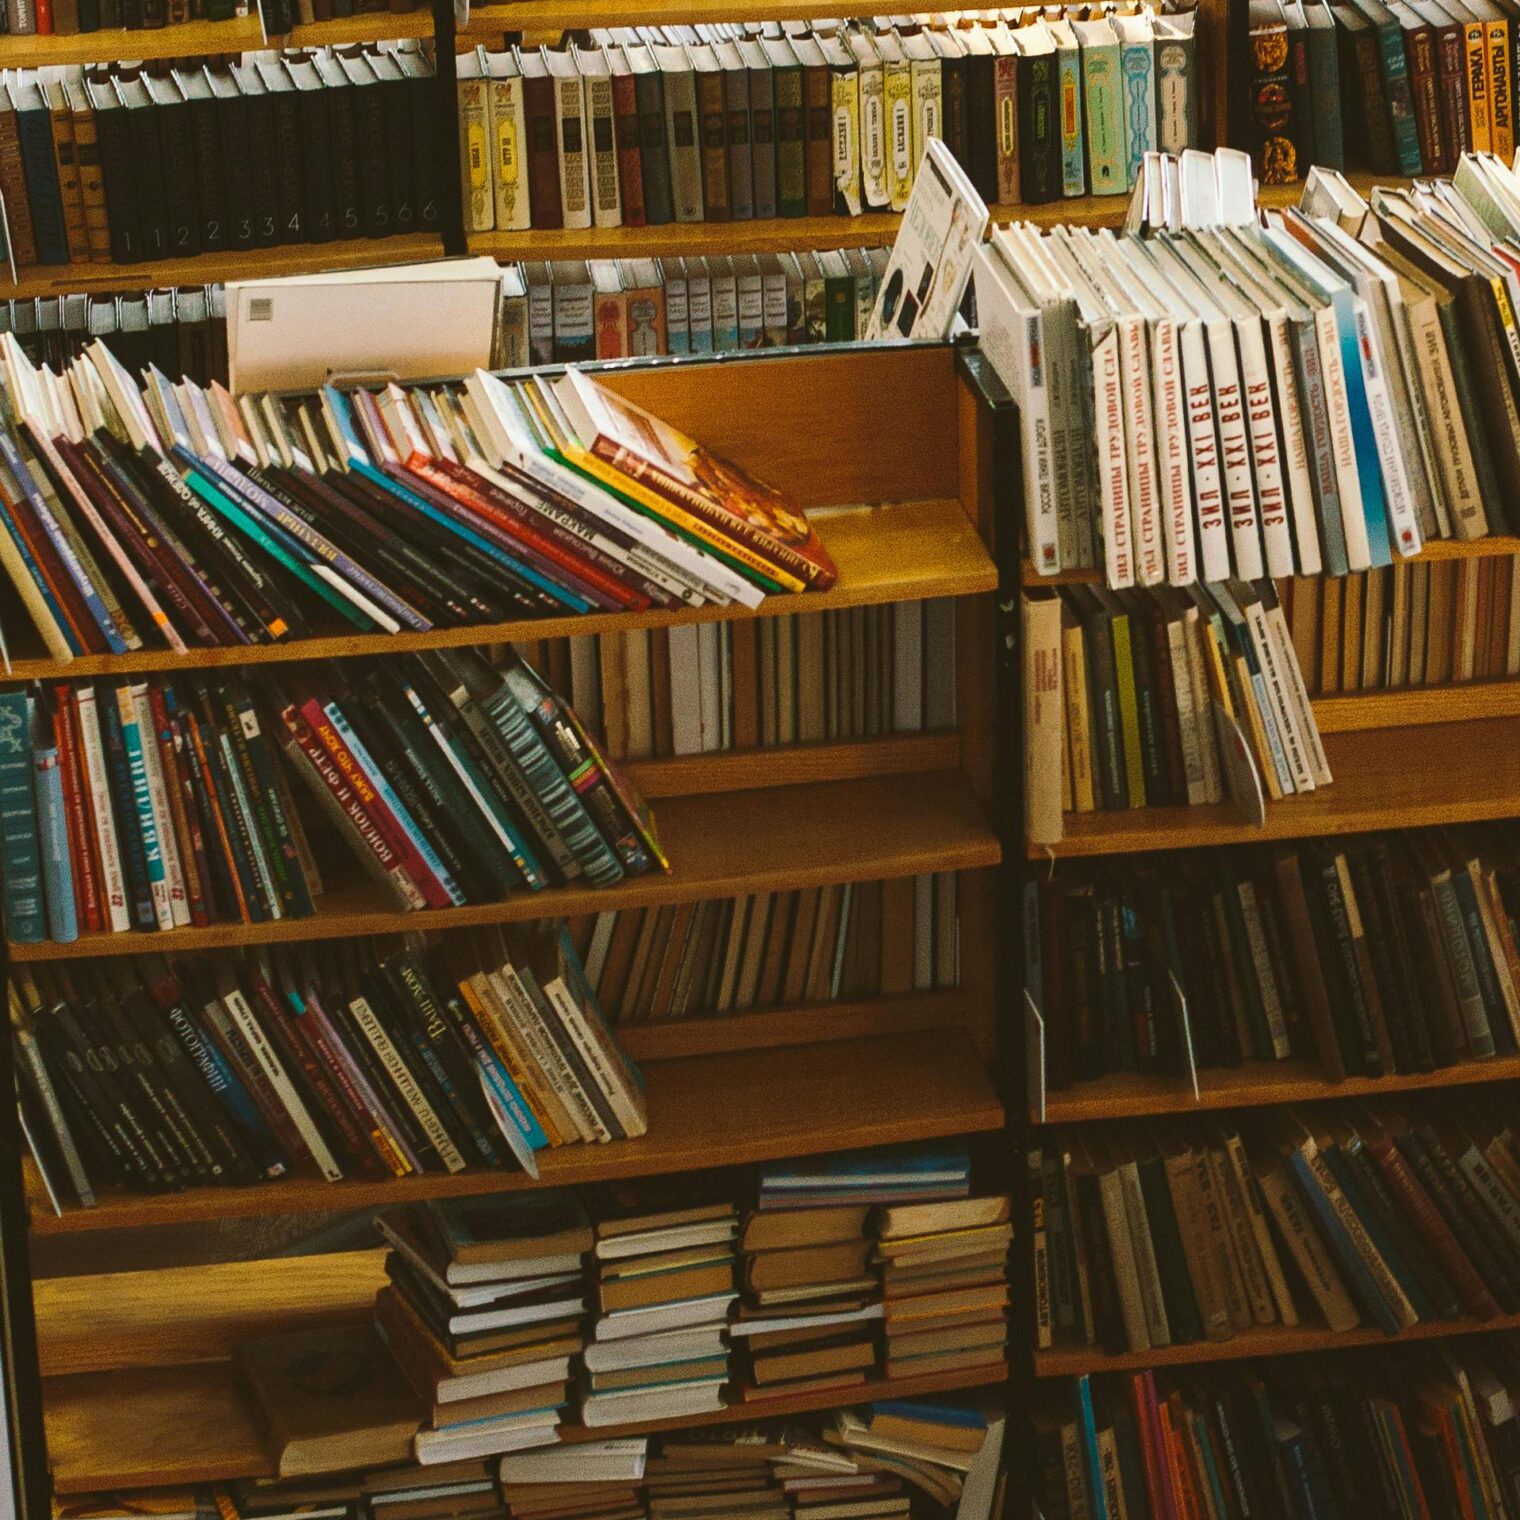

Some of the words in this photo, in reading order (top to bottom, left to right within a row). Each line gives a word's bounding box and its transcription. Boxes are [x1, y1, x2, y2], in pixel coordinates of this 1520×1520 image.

[1471, 48, 1485, 100] ГЕРАКЛ
[1492, 46, 1508, 128] АРГОНАВТЫ
[239, 218, 252, 239] 3
[262, 217, 275, 237] 3
[287, 212, 301, 232] 4
[318, 210, 332, 229] 4
[344, 208, 359, 228] 5
[375, 206, 389, 226] 5
[398, 201, 413, 222] 6
[422, 200, 438, 221] 6
[122, 232, 132, 251] 1
[153, 228, 162, 247] 1
[177, 225, 189, 246] 2
[206, 220, 220, 240] 2
[1161, 324, 1175, 376] СЛАВЫ
[1190, 384, 1209, 422] ВЕК
[1218, 384, 1239, 422] ВЕК
[1247, 382, 1269, 419] ВЕК
[1329, 363, 1347, 425] ГОРДОСТЬ
[1105, 382, 1121, 460] ТРУДОВОЙ
[1132, 377, 1149, 455] ТРУДОВОЙ
[1164, 381, 1181, 458] ТРУДОВОЙ
[1309, 384, 1326, 449] ГОРДОСТЬ
[1336, 428, 1352, 467] НАША
[538, 499, 596, 540] МАКРАМЕ
[1110, 466, 1125, 547] СТРАНИЦЫ
[1139, 462, 1154, 541] СТРАНИЦЫ
[1171, 465, 1187, 545] СТРАНИЦЫ
[1200, 490, 1222, 528] ЗИЛ
[1228, 490, 1254, 528] ЗИЛ
[1259, 487, 1285, 526] ЗИЛ
[196, 507, 224, 540] КНИГА
[1116, 553, 1129, 581] ЗИЛ
[1175, 552, 1189, 577] ЗИЛ
[318, 723, 345, 752] ХОЧУ
[308, 747, 341, 786] ФЕТР
[335, 750, 361, 774] ЧТО
[335, 787, 352, 801] И
[349, 773, 376, 802] ВЯЖУ
[348, 801, 394, 862] ВОЙЛОК
[402, 968, 426, 998] ДОМ
[421, 1001, 446, 1038] ВАШ
